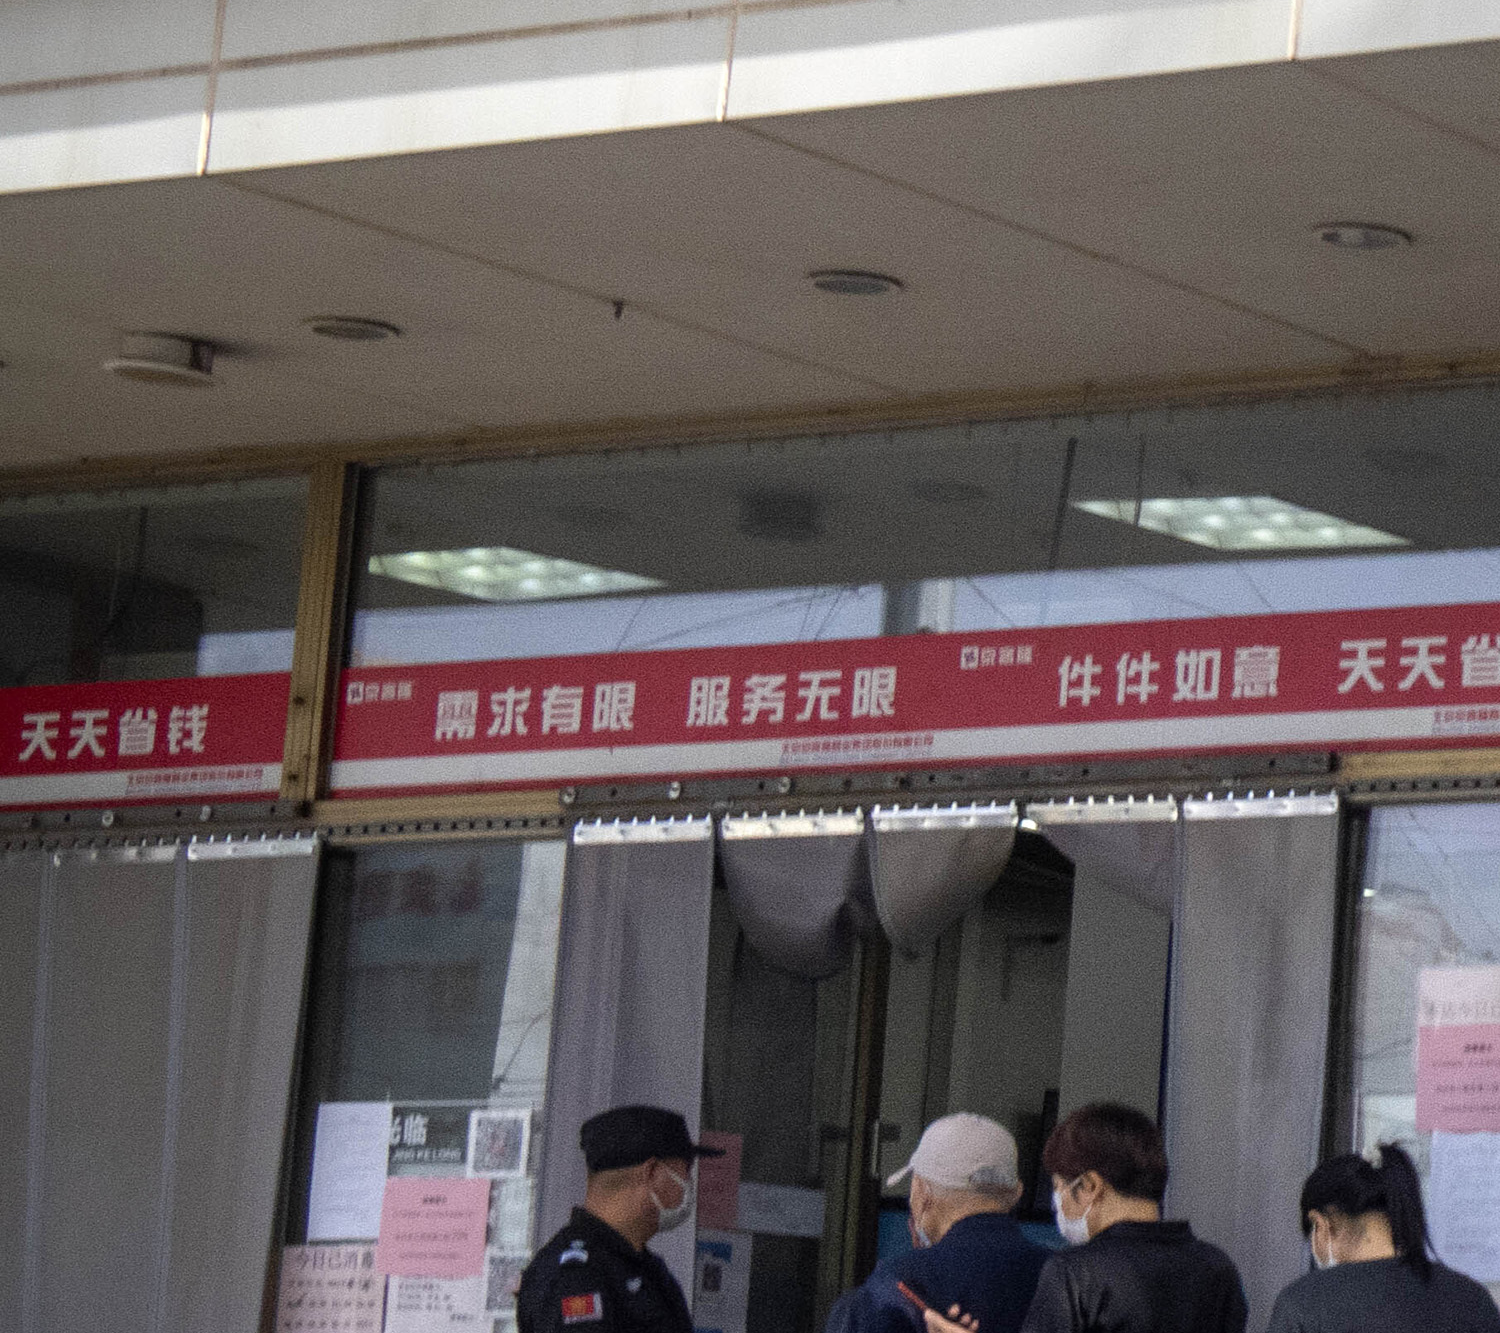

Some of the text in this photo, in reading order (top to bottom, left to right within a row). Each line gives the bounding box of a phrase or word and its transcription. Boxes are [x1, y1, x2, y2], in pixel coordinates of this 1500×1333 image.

[435, 667, 898, 742] 需求有限 服务无限
[1059, 644, 1280, 708] 件件如意
[18, 704, 210, 763] 天天省钱
